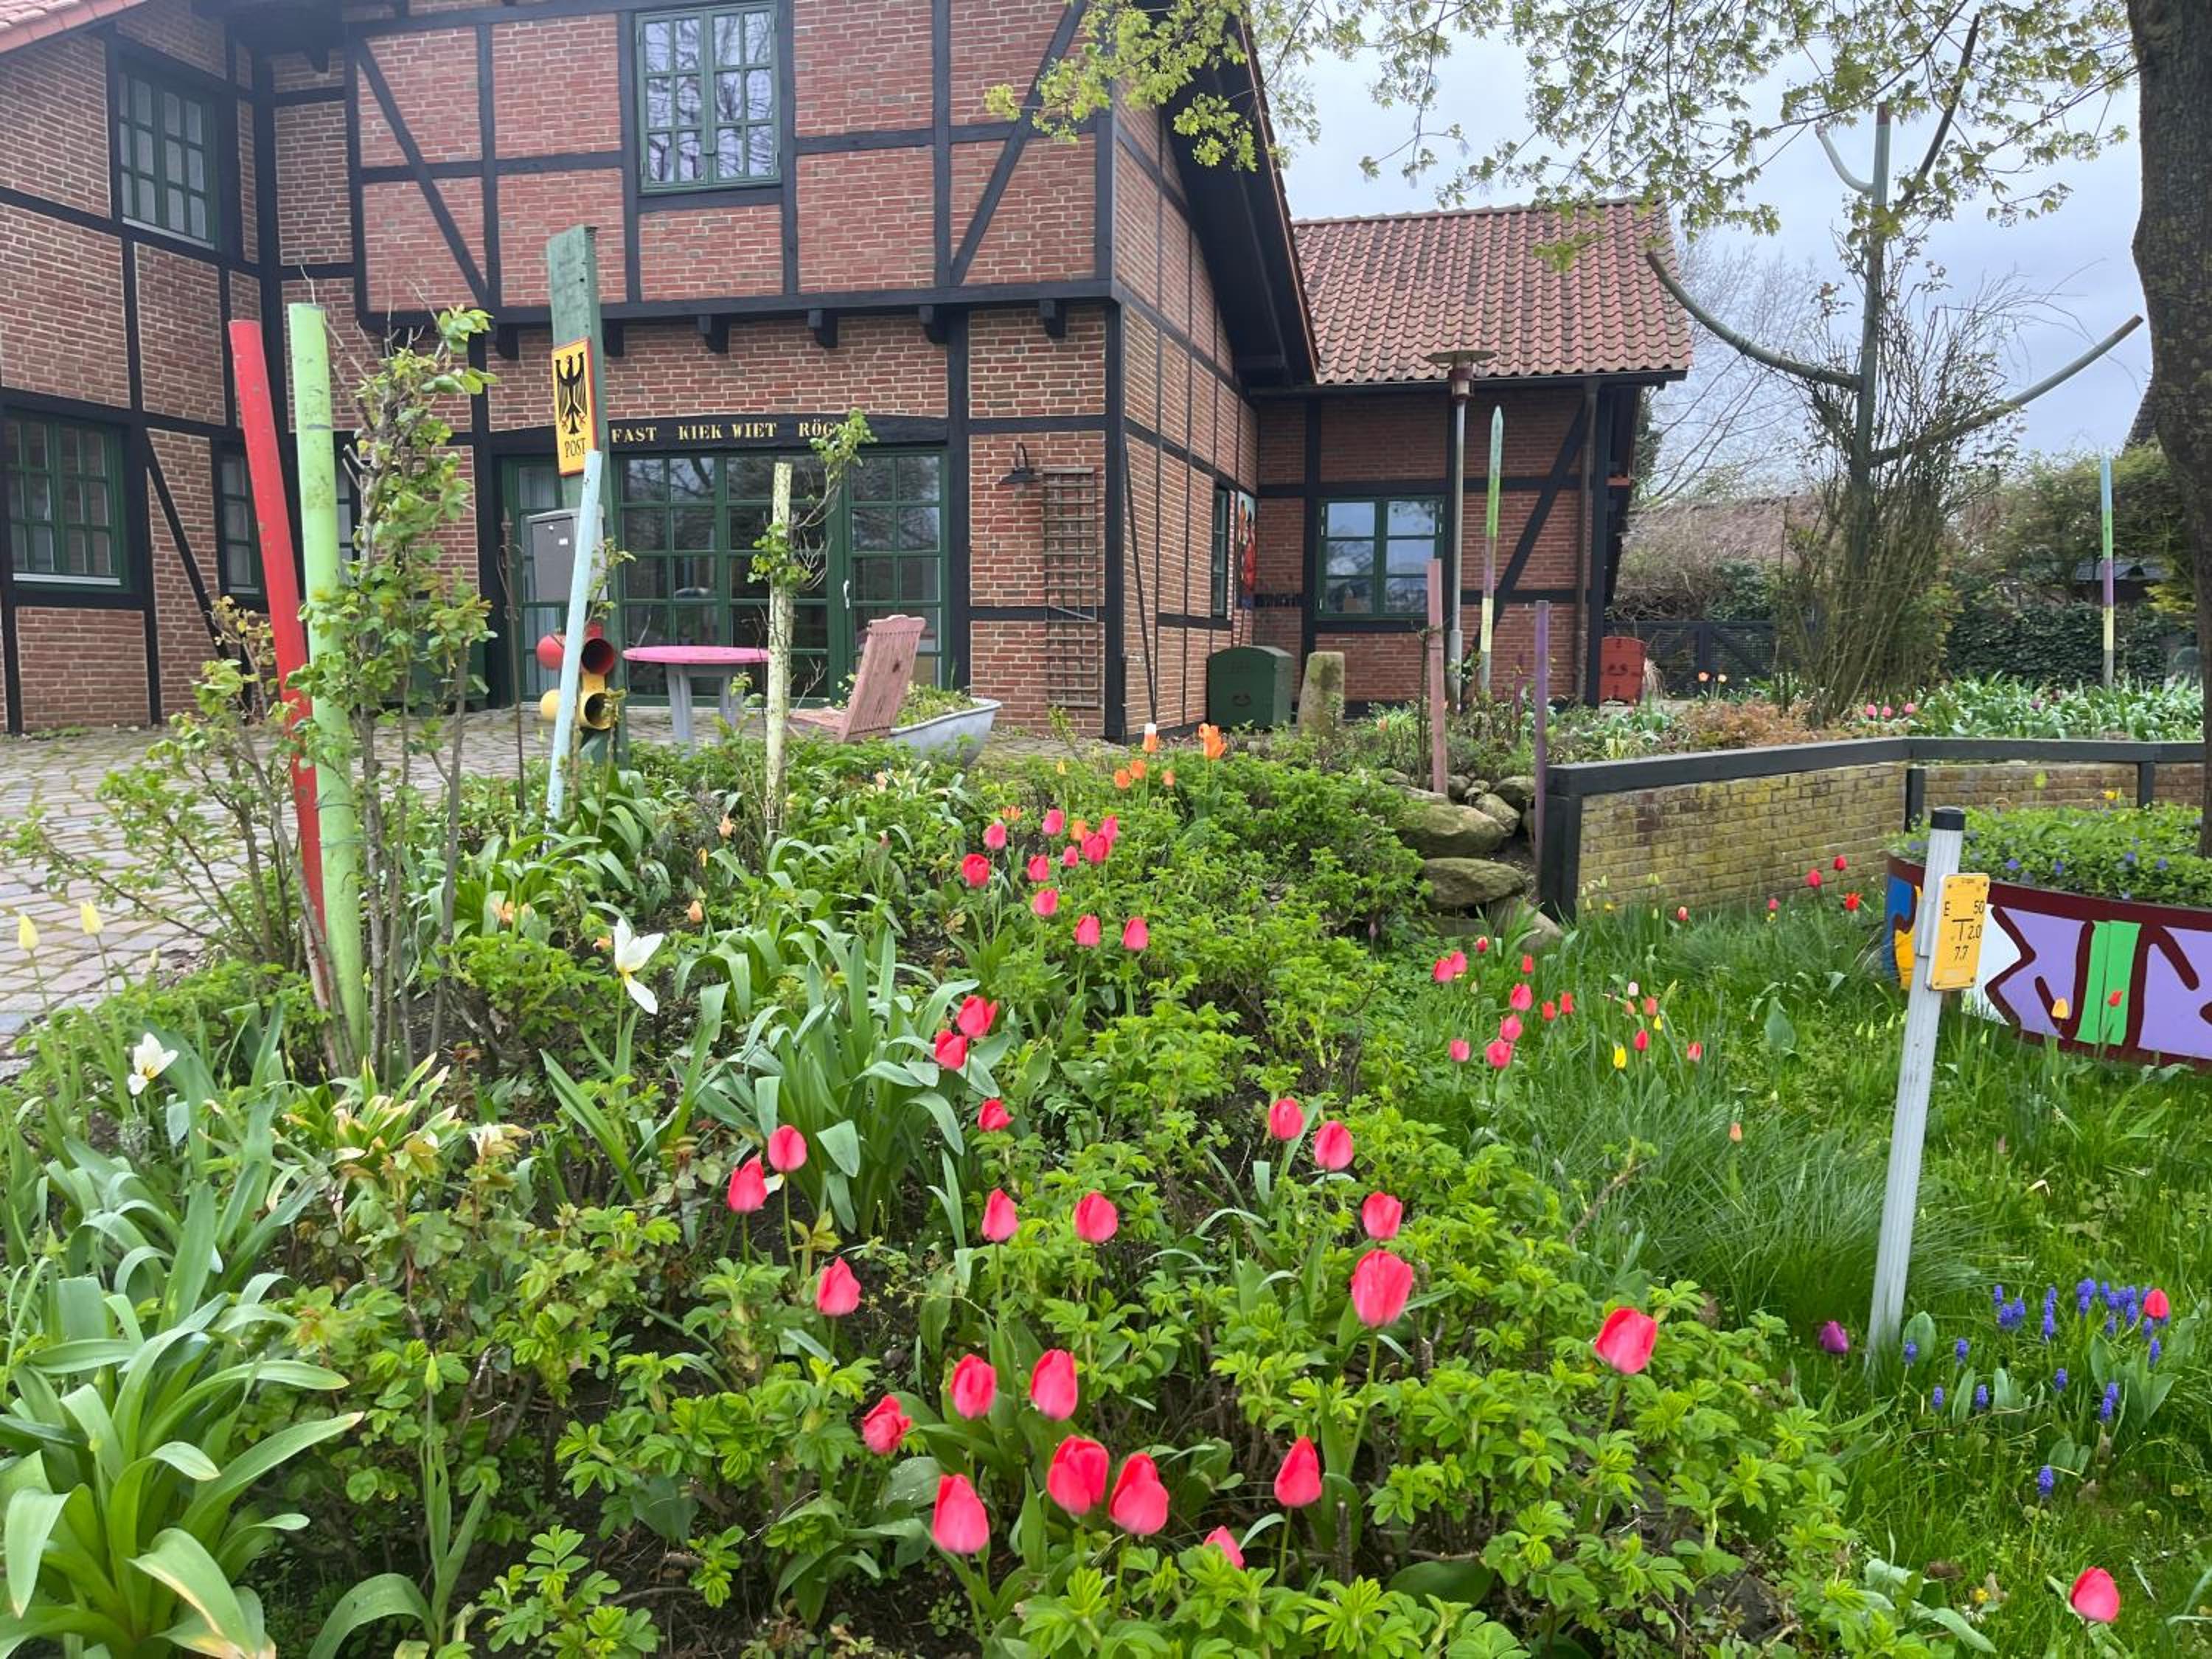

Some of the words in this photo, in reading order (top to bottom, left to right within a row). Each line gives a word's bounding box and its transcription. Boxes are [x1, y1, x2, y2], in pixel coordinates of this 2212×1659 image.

[611, 427, 657, 443] FAST
[678, 424, 723, 440] KIEK
[731, 422, 776, 439] WIET
[565, 437, 586, 458] POST
[1943, 901, 1950, 917] E
[1973, 900, 1985, 914] 50
